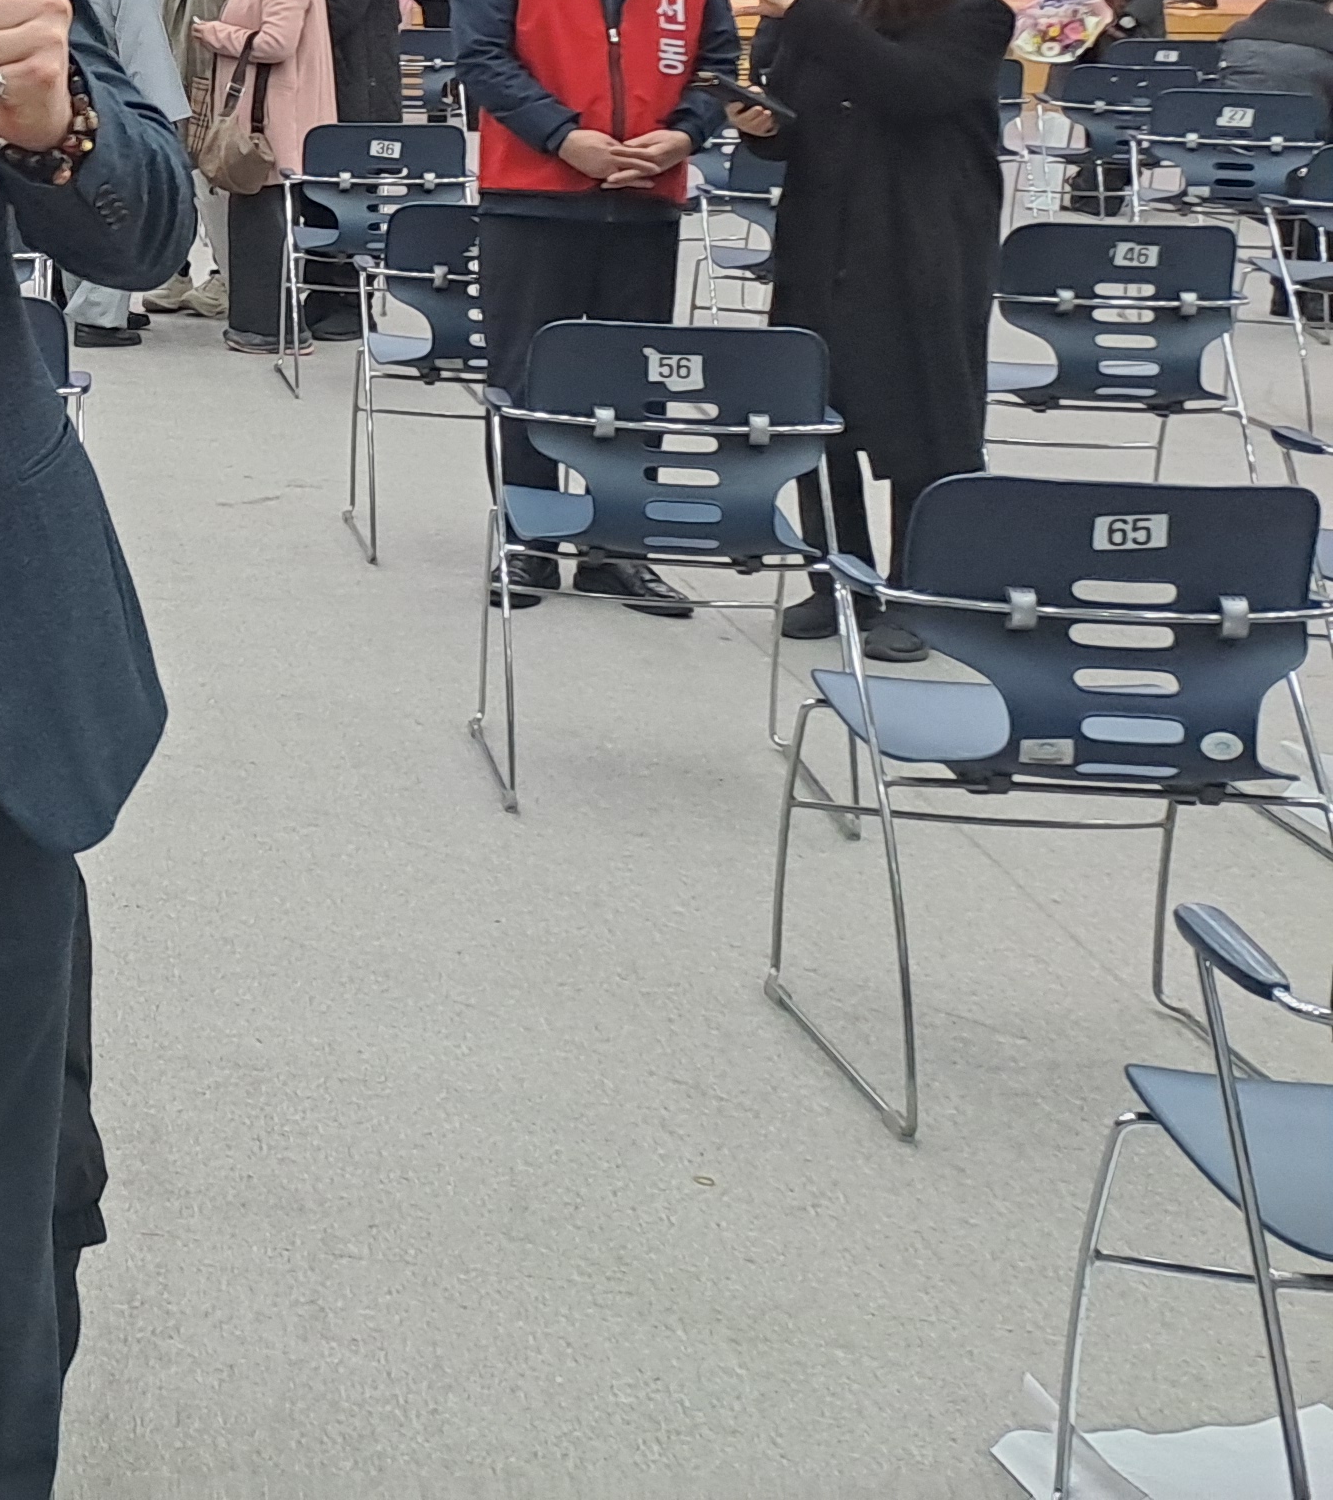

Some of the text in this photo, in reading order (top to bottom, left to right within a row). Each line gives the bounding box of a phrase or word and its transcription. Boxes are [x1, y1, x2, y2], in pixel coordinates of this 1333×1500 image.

[376, 141, 396, 156] 36
[1122, 247, 1150, 265] 46
[658, 356, 692, 379] 56
[1107, 517, 1153, 547] 65
